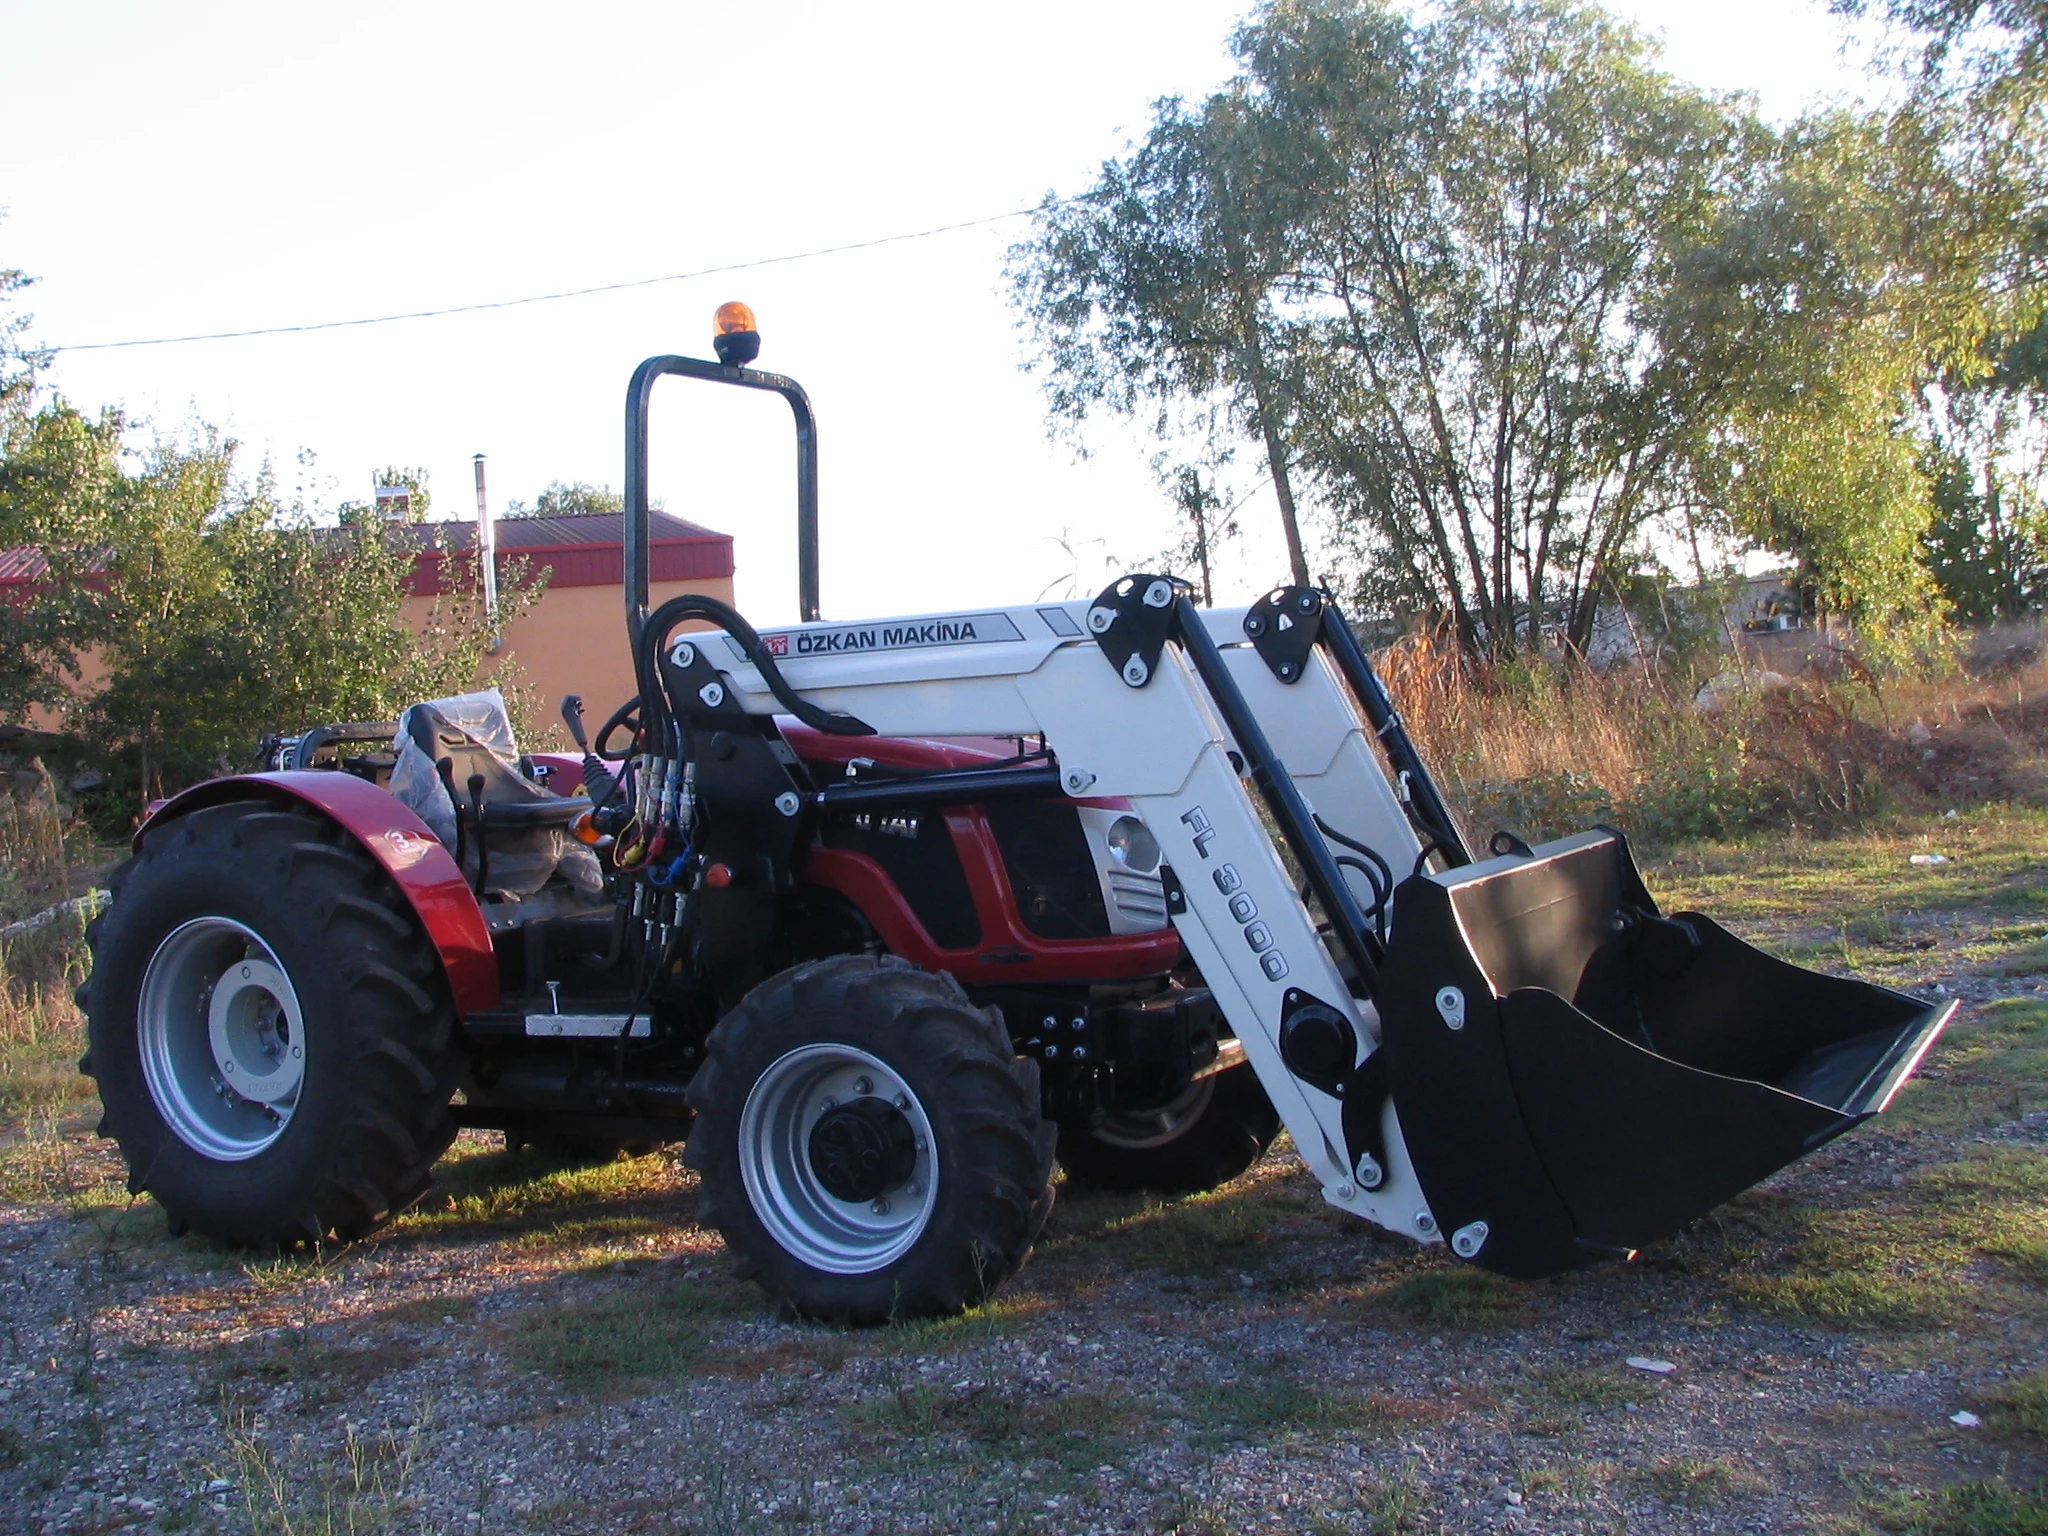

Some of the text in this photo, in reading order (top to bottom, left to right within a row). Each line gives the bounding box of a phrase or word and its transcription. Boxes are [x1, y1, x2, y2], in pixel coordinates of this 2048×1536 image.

[797, 629, 876, 653] ÖZKAN
[883, 620, 977, 647] MAKİNA
[1180, 805, 1290, 982] FL 3000
